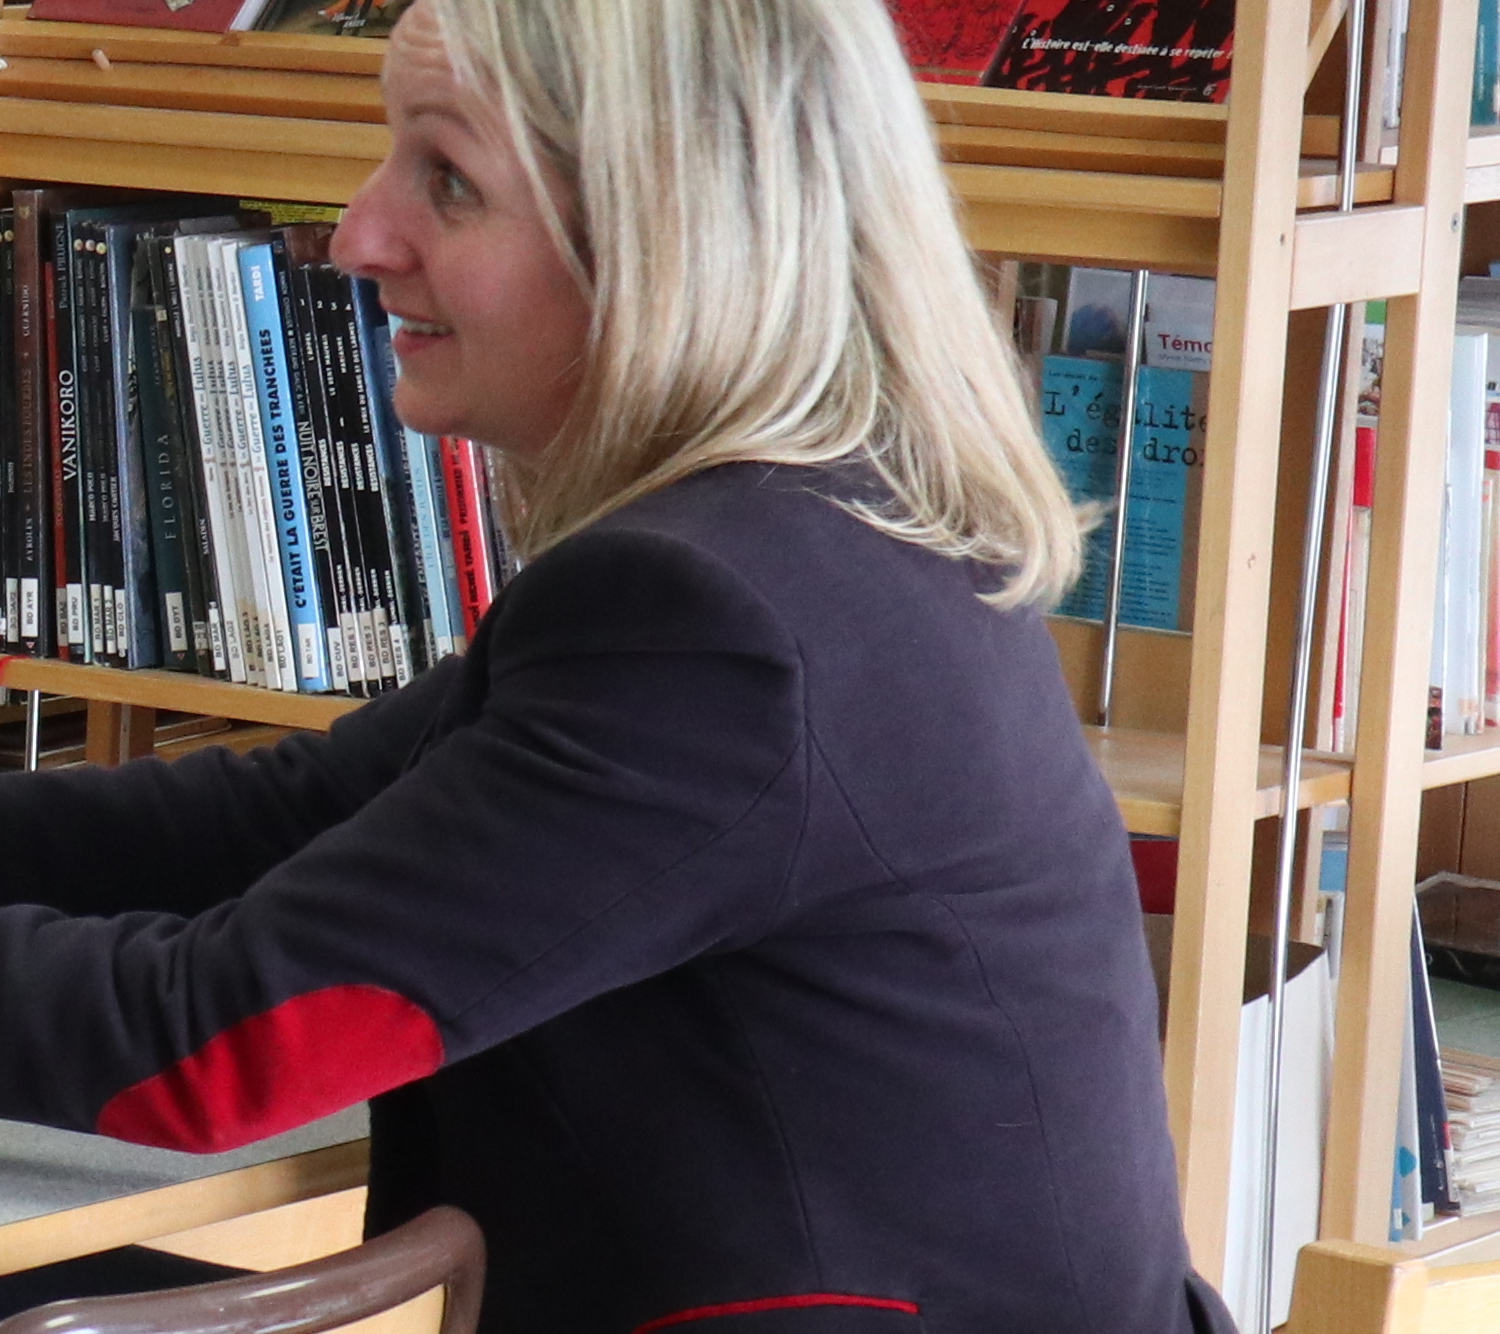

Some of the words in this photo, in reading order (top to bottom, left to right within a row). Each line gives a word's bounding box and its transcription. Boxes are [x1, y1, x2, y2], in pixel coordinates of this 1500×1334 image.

[1021, 37, 1072, 52] L'Histoire
[1072, 40, 1114, 53] est-elle
[1114, 42, 1158, 57] destinée
[1169, 46, 1182, 57] se
[253, 265, 266, 303] TARDI
[194, 356, 205, 391] Lulus
[228, 360, 240, 396] Lulus
[242, 363, 255, 400] Lulus
[58, 368, 78, 482] VANIKORO
[250, 412, 263, 454] Guerre
[272, 422, 287, 447] DES
[297, 420, 315, 450] NUIT
[1066, 428, 1119, 456] des
[157, 432, 178, 542] FLORIDA
[276, 449, 296, 523] GUERRE
[301, 449, 322, 499] NOIRE
[288, 531, 300, 553] LA
[310, 512, 330, 551] BREST
